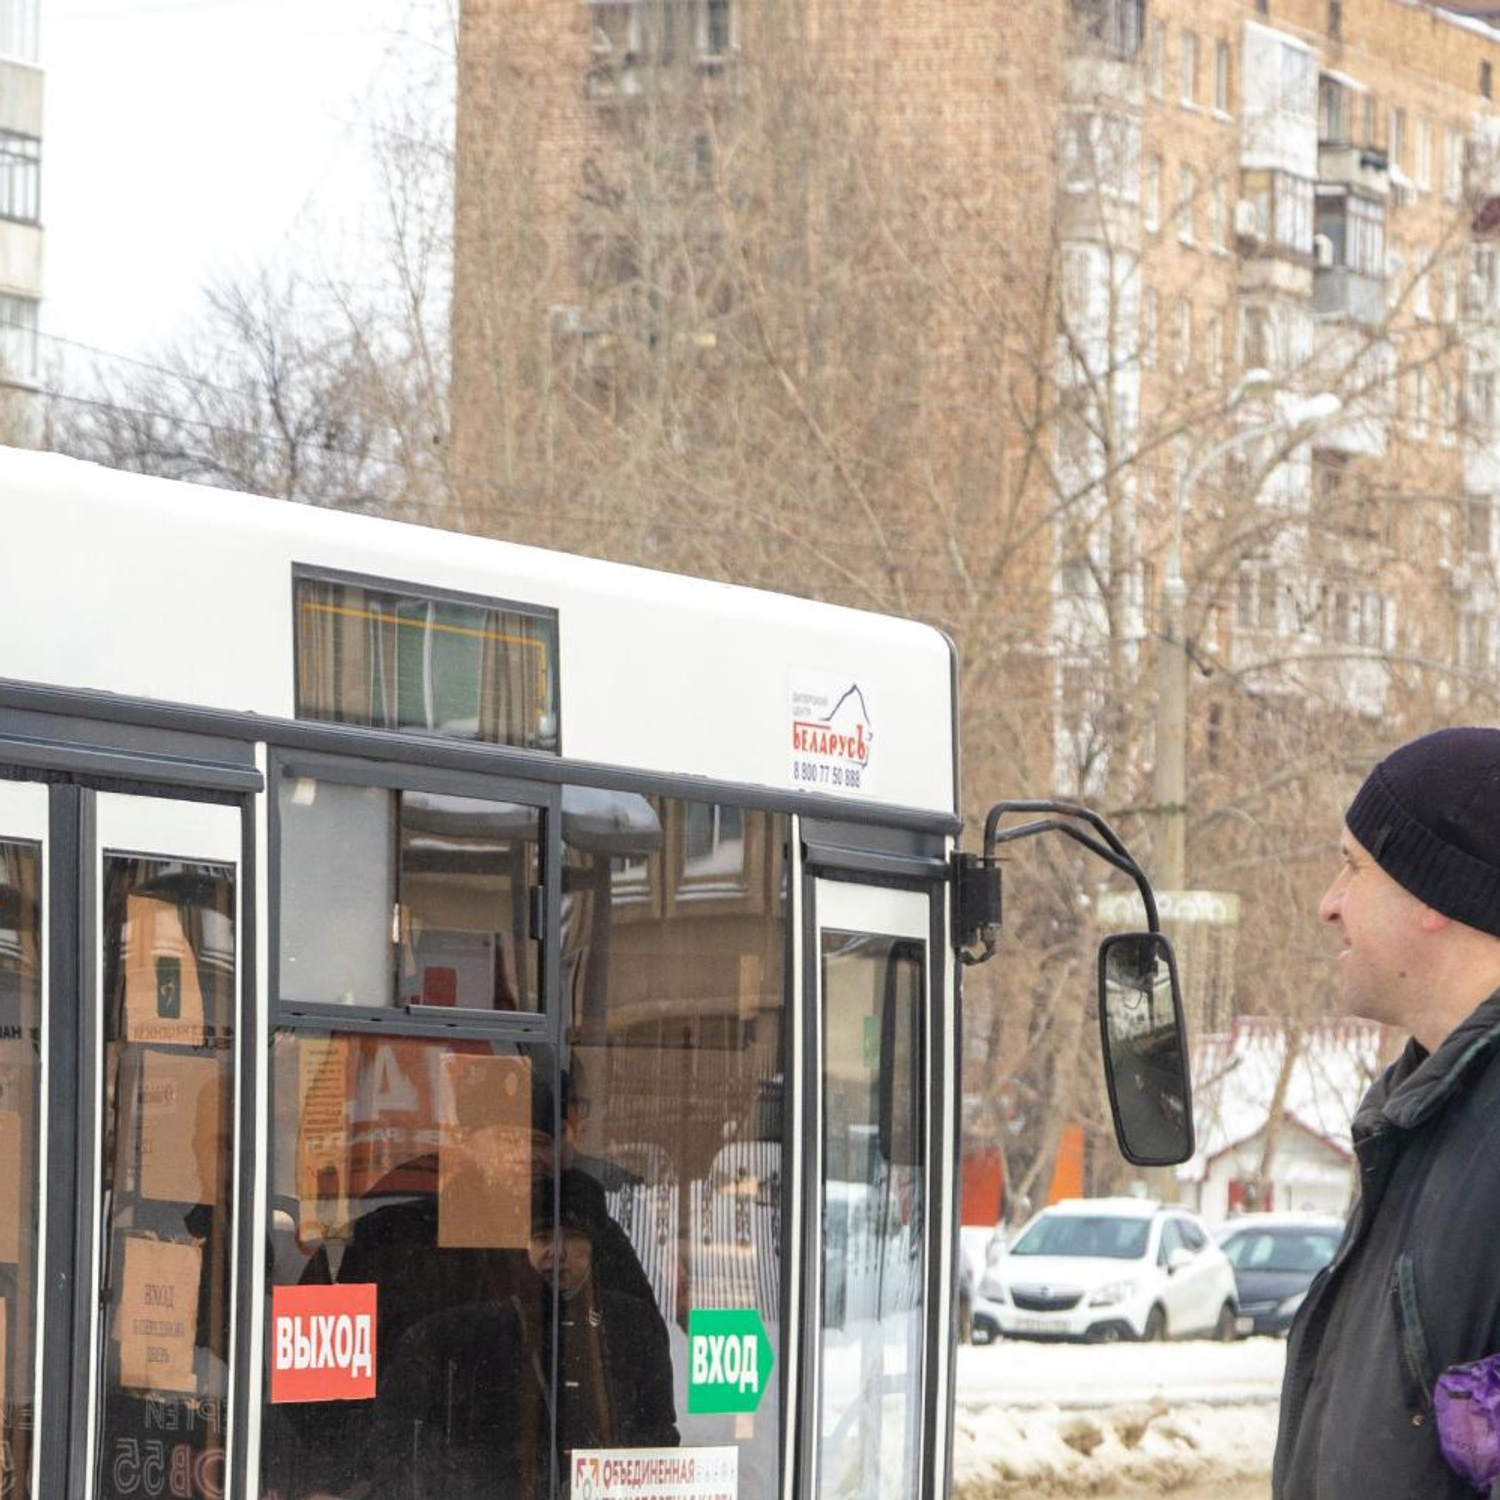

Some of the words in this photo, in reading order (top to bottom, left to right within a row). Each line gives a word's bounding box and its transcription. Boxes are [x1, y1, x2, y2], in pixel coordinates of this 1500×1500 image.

[793, 721, 867, 761] БЕЛАРУСЬ
[793, 760, 800, 780] 8
[276, 1313, 373, 1379] ВЫХОД
[692, 1334, 759, 1395] ВХОД
[603, 1457, 696, 1490] ОБЪЕДИНЕННАЯ
